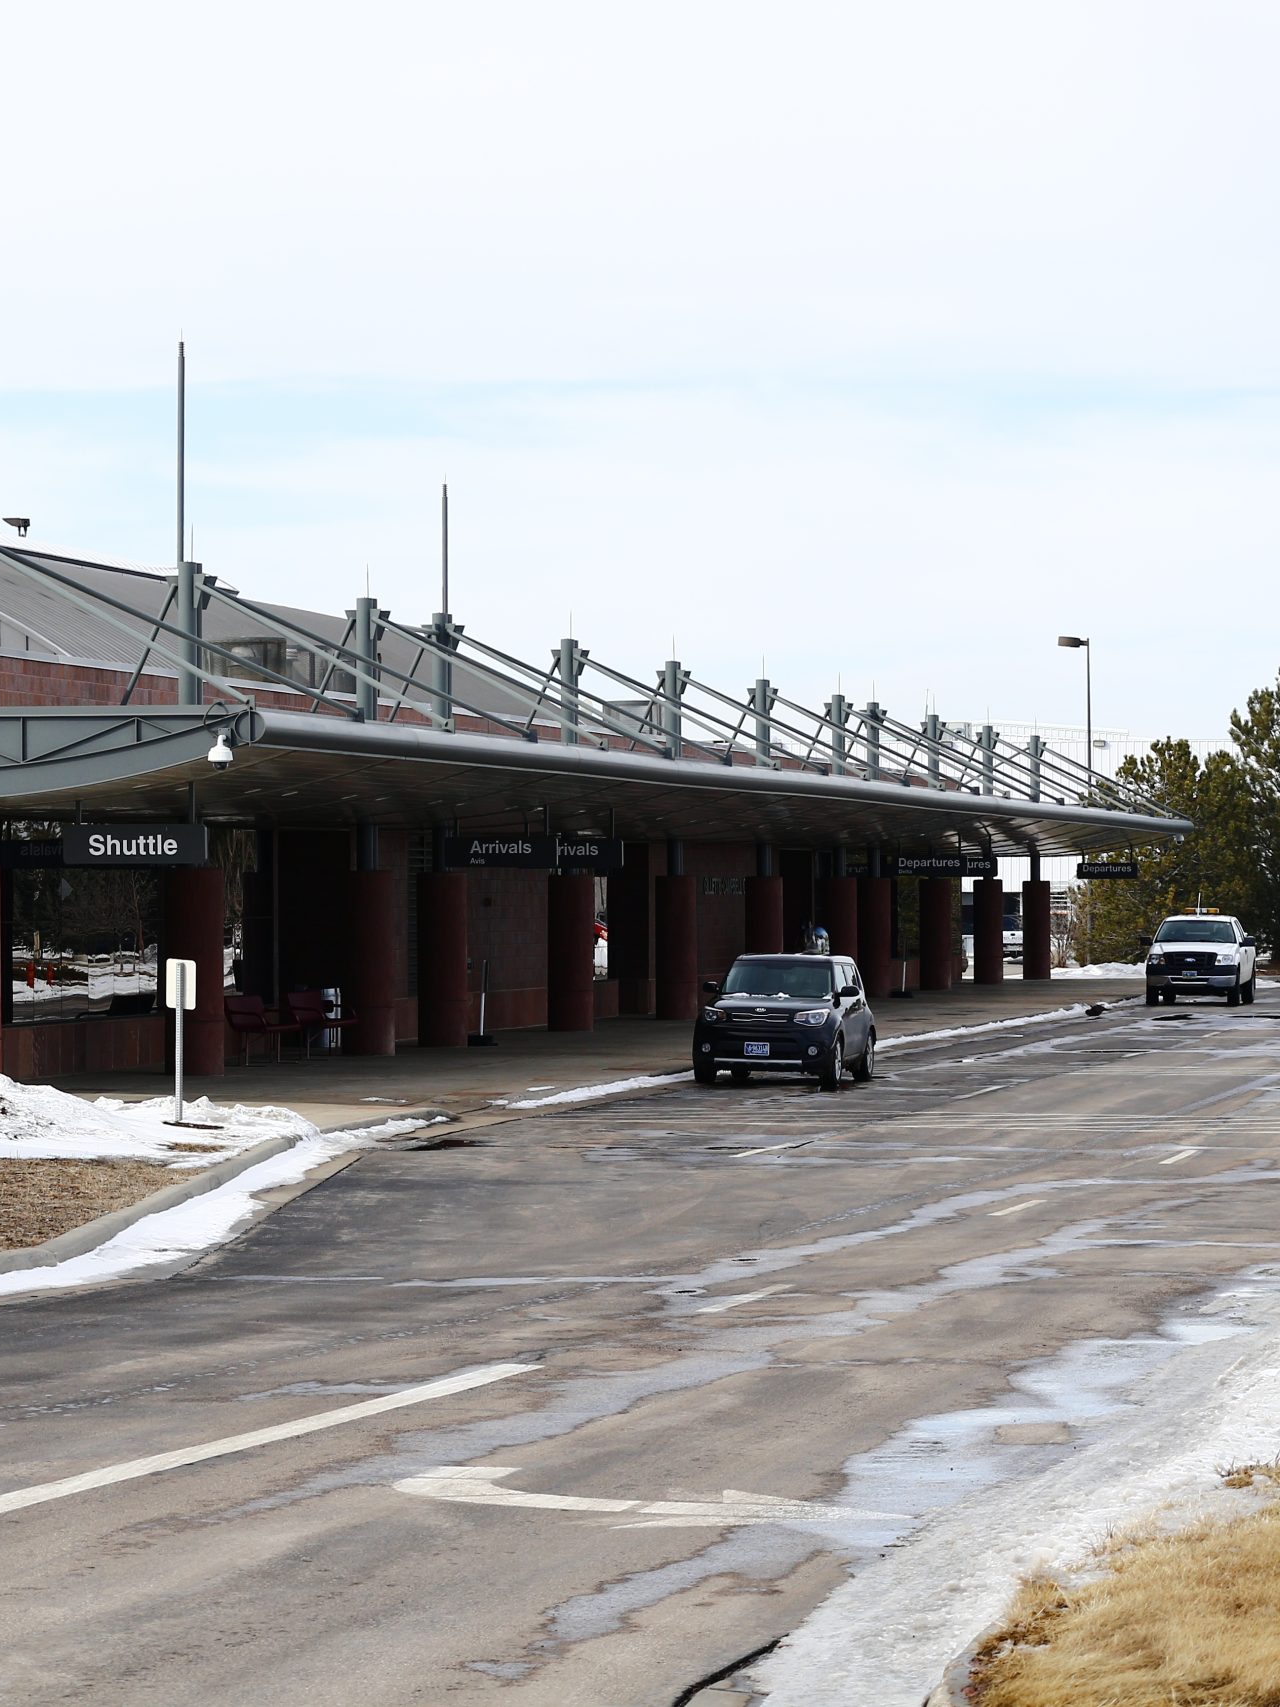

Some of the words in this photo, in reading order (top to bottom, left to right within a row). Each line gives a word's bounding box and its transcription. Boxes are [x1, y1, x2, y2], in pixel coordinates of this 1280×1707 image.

[88, 834, 178, 856] Shuttle
[470, 840, 532, 854] Arrivals
[470, 857, 486, 865] Avis
[898, 857, 960, 869] Departures
[1082, 864, 1132, 874] Departures
